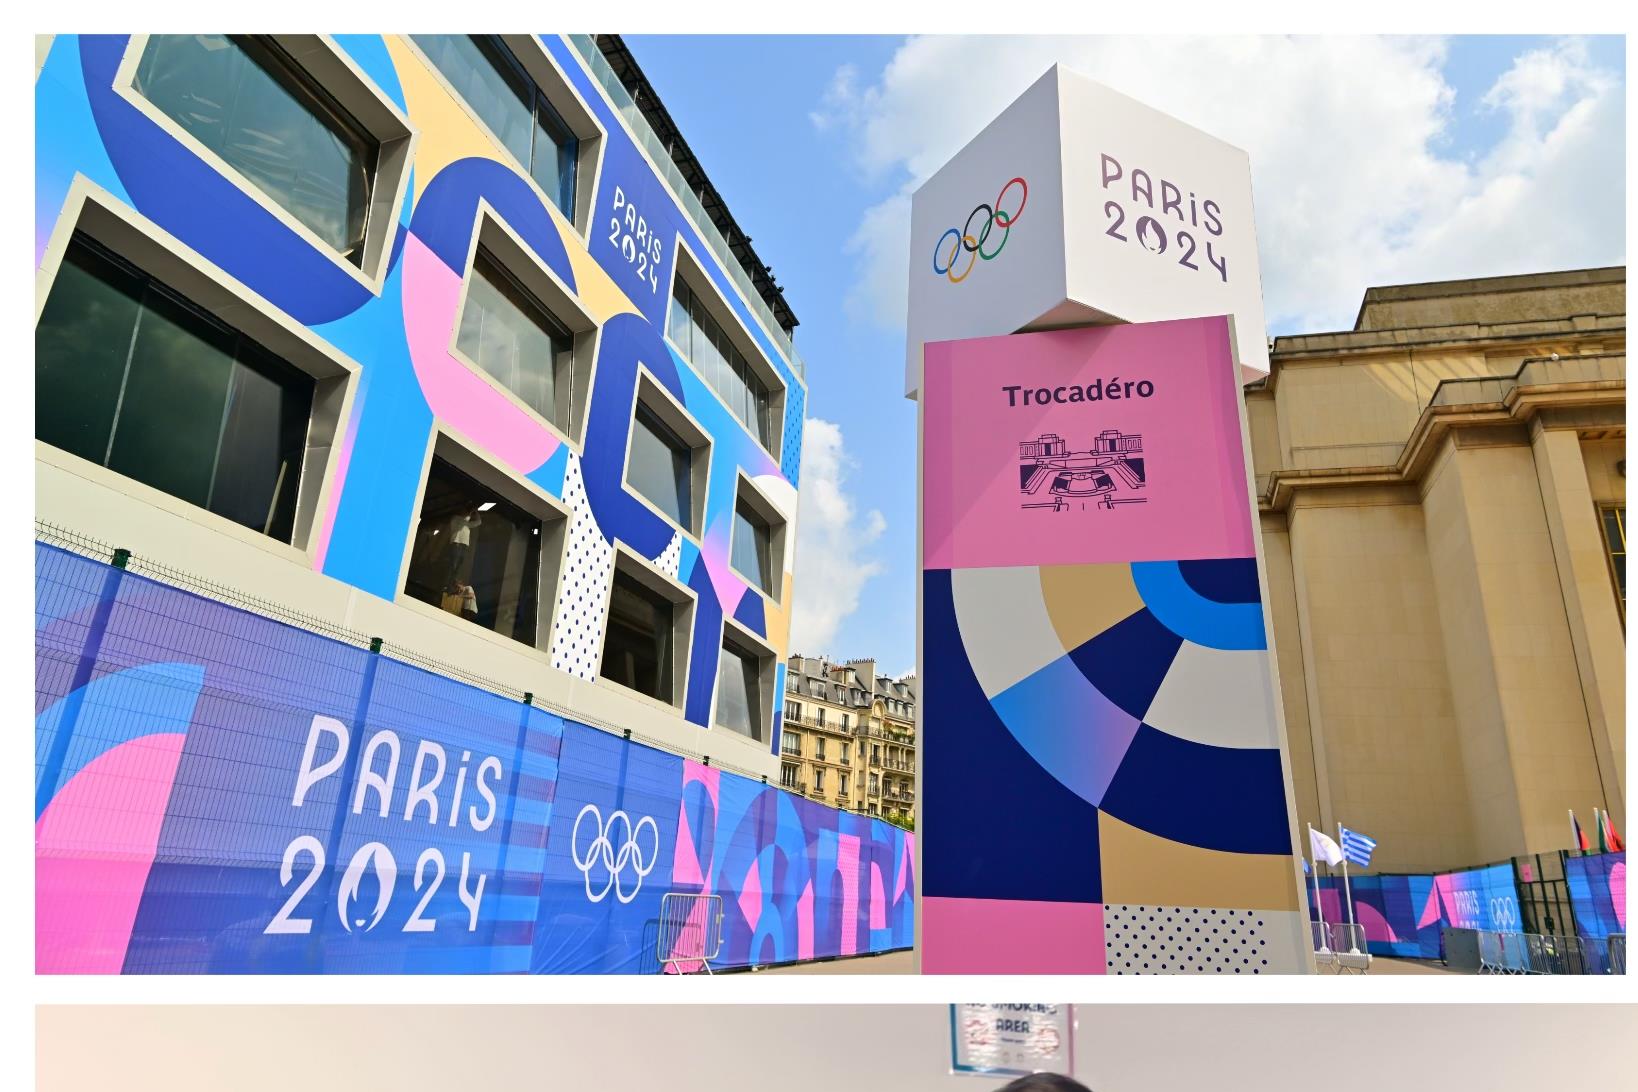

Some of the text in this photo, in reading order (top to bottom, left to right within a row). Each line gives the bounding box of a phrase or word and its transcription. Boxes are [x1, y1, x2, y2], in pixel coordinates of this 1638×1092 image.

[608, 217, 658, 294] 2024
[1104, 201, 1227, 282] 2024
[1002, 377, 1154, 407] Trocadéro
[263, 835, 487, 935] 2024
[996, 1018, 1030, 1033] AREA
